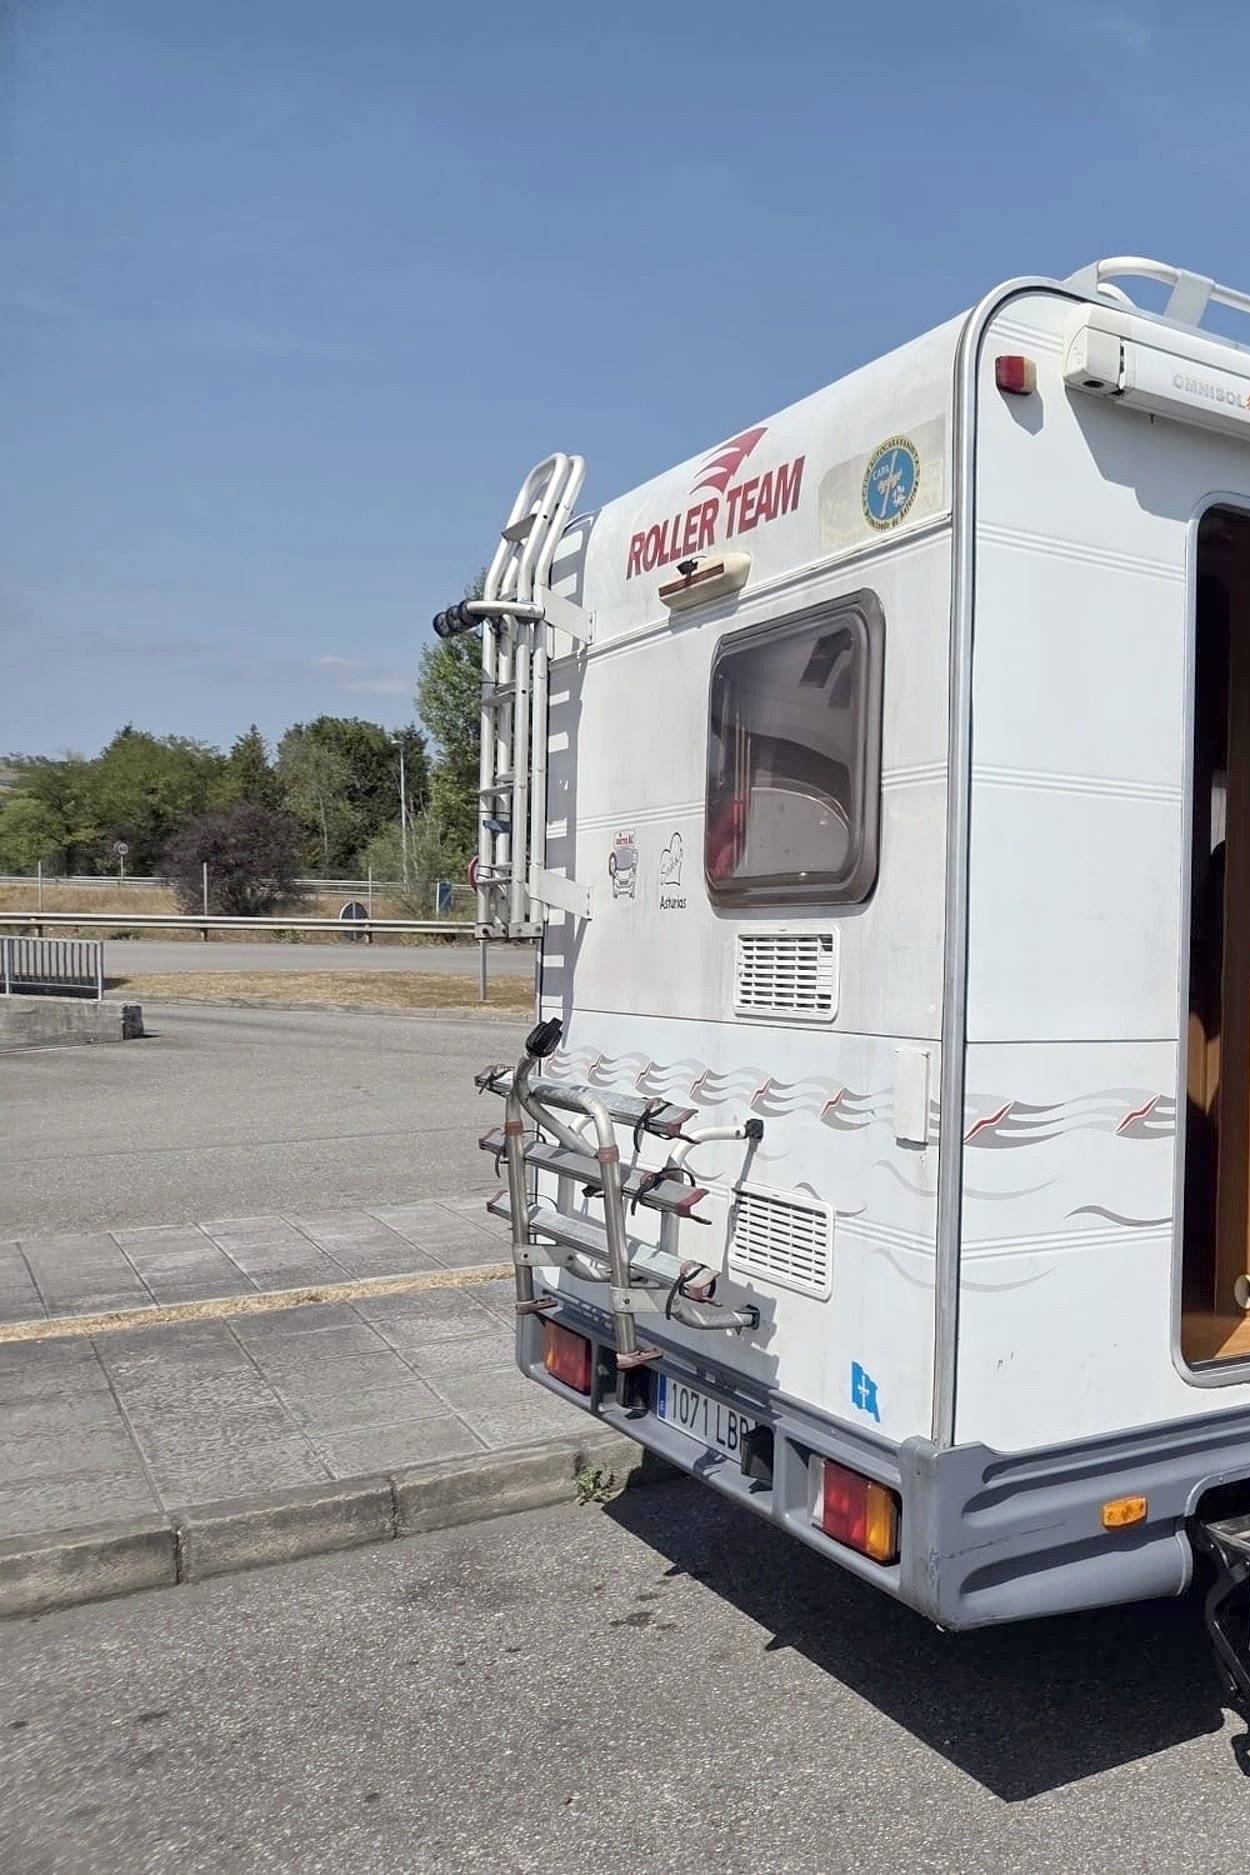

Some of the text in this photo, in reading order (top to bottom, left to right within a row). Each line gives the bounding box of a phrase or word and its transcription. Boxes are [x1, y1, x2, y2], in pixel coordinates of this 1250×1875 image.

[1172, 374, 1246, 409] OMNISOL
[626, 498, 720, 581] ROLLER
[726, 455, 806, 540] TEAM
[659, 895, 687, 910] Asturias
[672, 1383, 709, 1437] 1071
